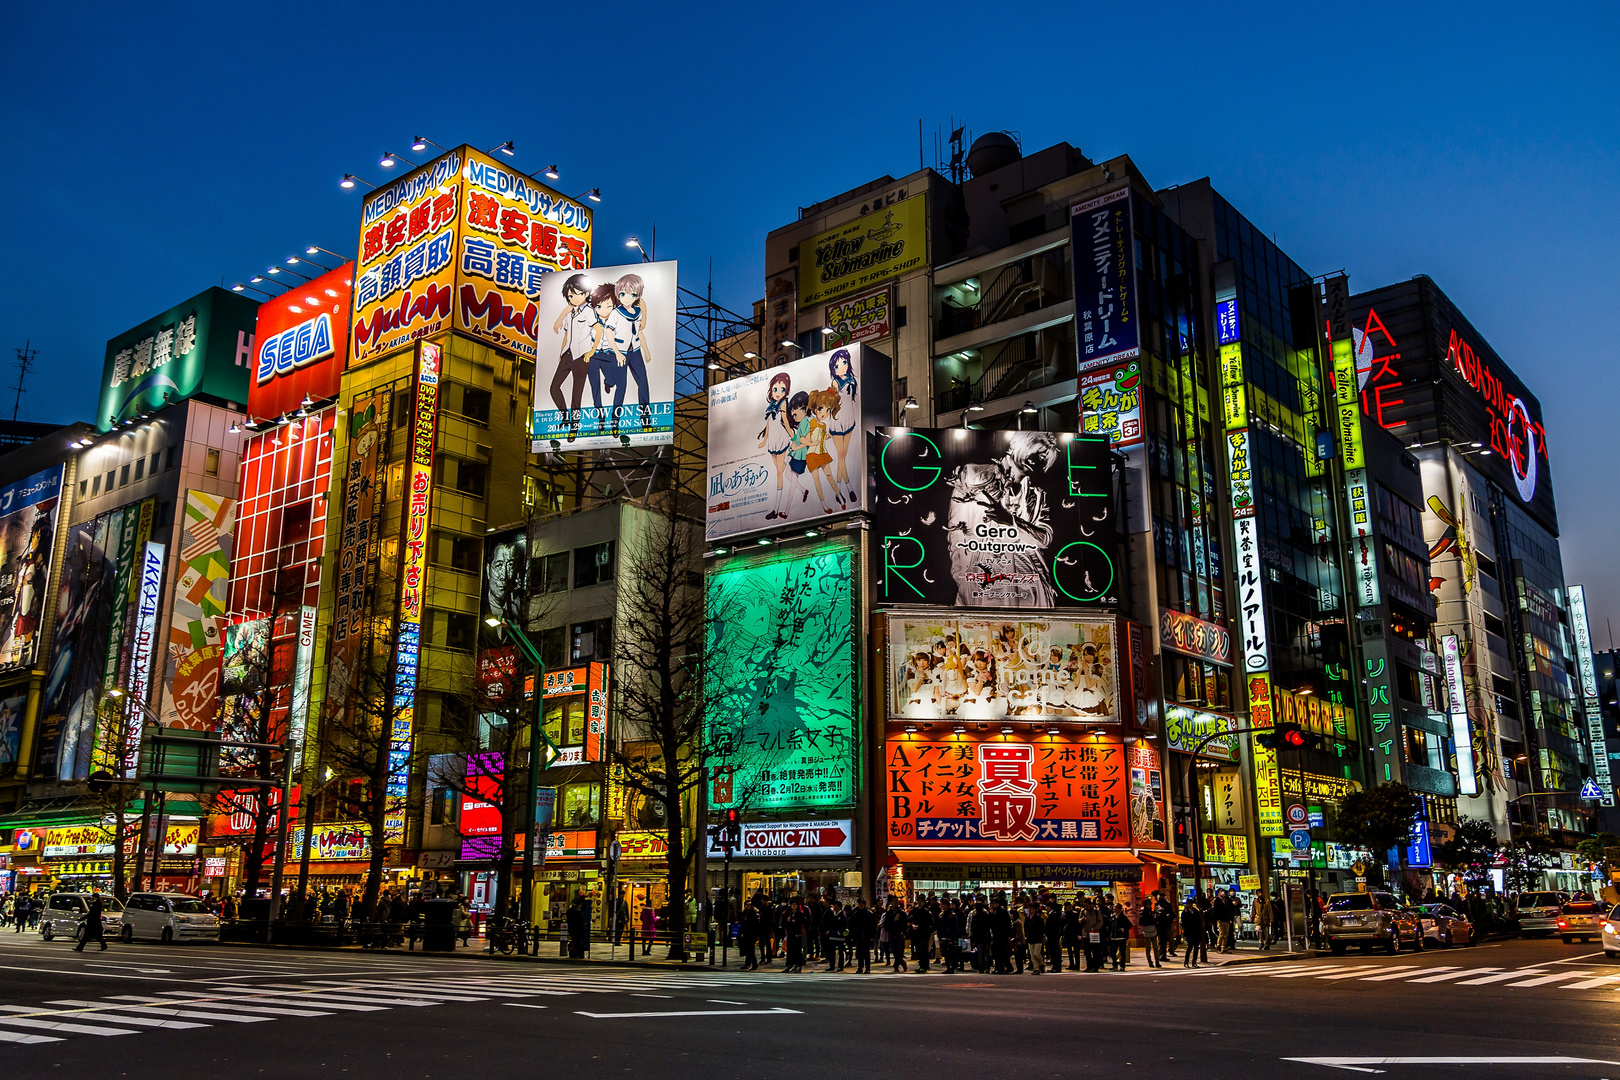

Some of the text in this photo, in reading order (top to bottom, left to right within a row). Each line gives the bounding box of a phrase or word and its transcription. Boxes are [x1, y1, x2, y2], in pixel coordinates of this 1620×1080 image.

[1074, 190, 1126, 213] AMENITY DREAM
[362, 184, 457, 265] 激安販売
[466, 189, 587, 271] 激安販売
[817, 225, 862, 245] HOBBY BASE
[816, 235, 864, 267] Yellow
[820, 240, 905, 283] Submarine
[356, 228, 454, 312] 高額買取
[1091, 210, 1118, 350] アメニティードリーム
[354, 282, 452, 359] Mulan
[829, 293, 888, 326] まんが喫茶
[257, 312, 335, 384] SEGA
[1082, 310, 1095, 354] 秋葉原店
[110, 314, 197, 390] 廣瀬無線
[1082, 350, 1136, 370] AMENITY DREAM
[418, 402, 435, 413] ゲーム
[419, 384, 436, 395] DVD
[1082, 387, 1138, 412] まんが
[416, 420, 434, 430] アイドル
[419, 411, 432, 421] CD
[581, 407, 611, 420] NOW
[614, 405, 634, 418] ON
[635, 403, 672, 416] SALE
[618, 419, 634, 427] ON
[634, 416, 658, 427] SALE
[1084, 411, 1119, 432] 喫茶
[1337, 368, 1355, 464] Yellow Submarine
[415, 429, 433, 439] アニメ
[415, 438, 432, 448] コミック
[1123, 428, 1139, 437] 3F
[1486, 407, 1527, 478] ZONE
[882, 432, 1108, 497] G E
[1230, 432, 1246, 471] まんが
[1350, 471, 1361, 479] 5F
[335, 458, 362, 641] 激安販売の専門店
[975, 524, 1018, 539] Gero
[350, 518, 370, 635] 高額買取と
[885, 535, 1114, 602] R O
[1239, 520, 1265, 652] 喫茶室ルノアール
[789, 563, 816, 648] わたし色に
[300, 611, 315, 648] GAME
[1160, 612, 1230, 660] メイドカジノ
[135, 631, 151, 675] DUTY
[547, 671, 575, 687] 吉野家
[999, 668, 1071, 686] home
[175, 700, 211, 731] DUTY
[590, 689, 601, 735] 吉野家
[1249, 677, 1273, 729] 免税
[1367, 658, 1393, 781] リバティー
[1450, 693, 1460, 714] cafe
[915, 745, 935, 815] アイドル
[934, 745, 955, 796] アニメ
[954, 744, 976, 817] 美少女系
[1039, 747, 1060, 818] フィギュア
[1059, 747, 1077, 798] ホビー
[1078, 747, 1101, 818] 携帯電話
[1267, 768, 1281, 808] FREE
[977, 744, 1039, 841] 買取
[1100, 748, 1123, 841] アップルとか
[385, 819, 404, 828] AKIBA
[917, 821, 1098, 839] チケット 大黒屋
[1292, 809, 1304, 819] 40
[47, 830, 65, 846] Duty
[65, 828, 82, 845] Free
[82, 827, 99, 843] Shop
[174, 828, 199, 854] SHOP
[319, 828, 364, 855] Mulan
[745, 832, 795, 847] COMIC
[798, 830, 820, 847] ZIN
[1294, 835, 1303, 847] P
[205, 857, 226, 866] GAME
[421, 853, 453, 866] ラーメン
